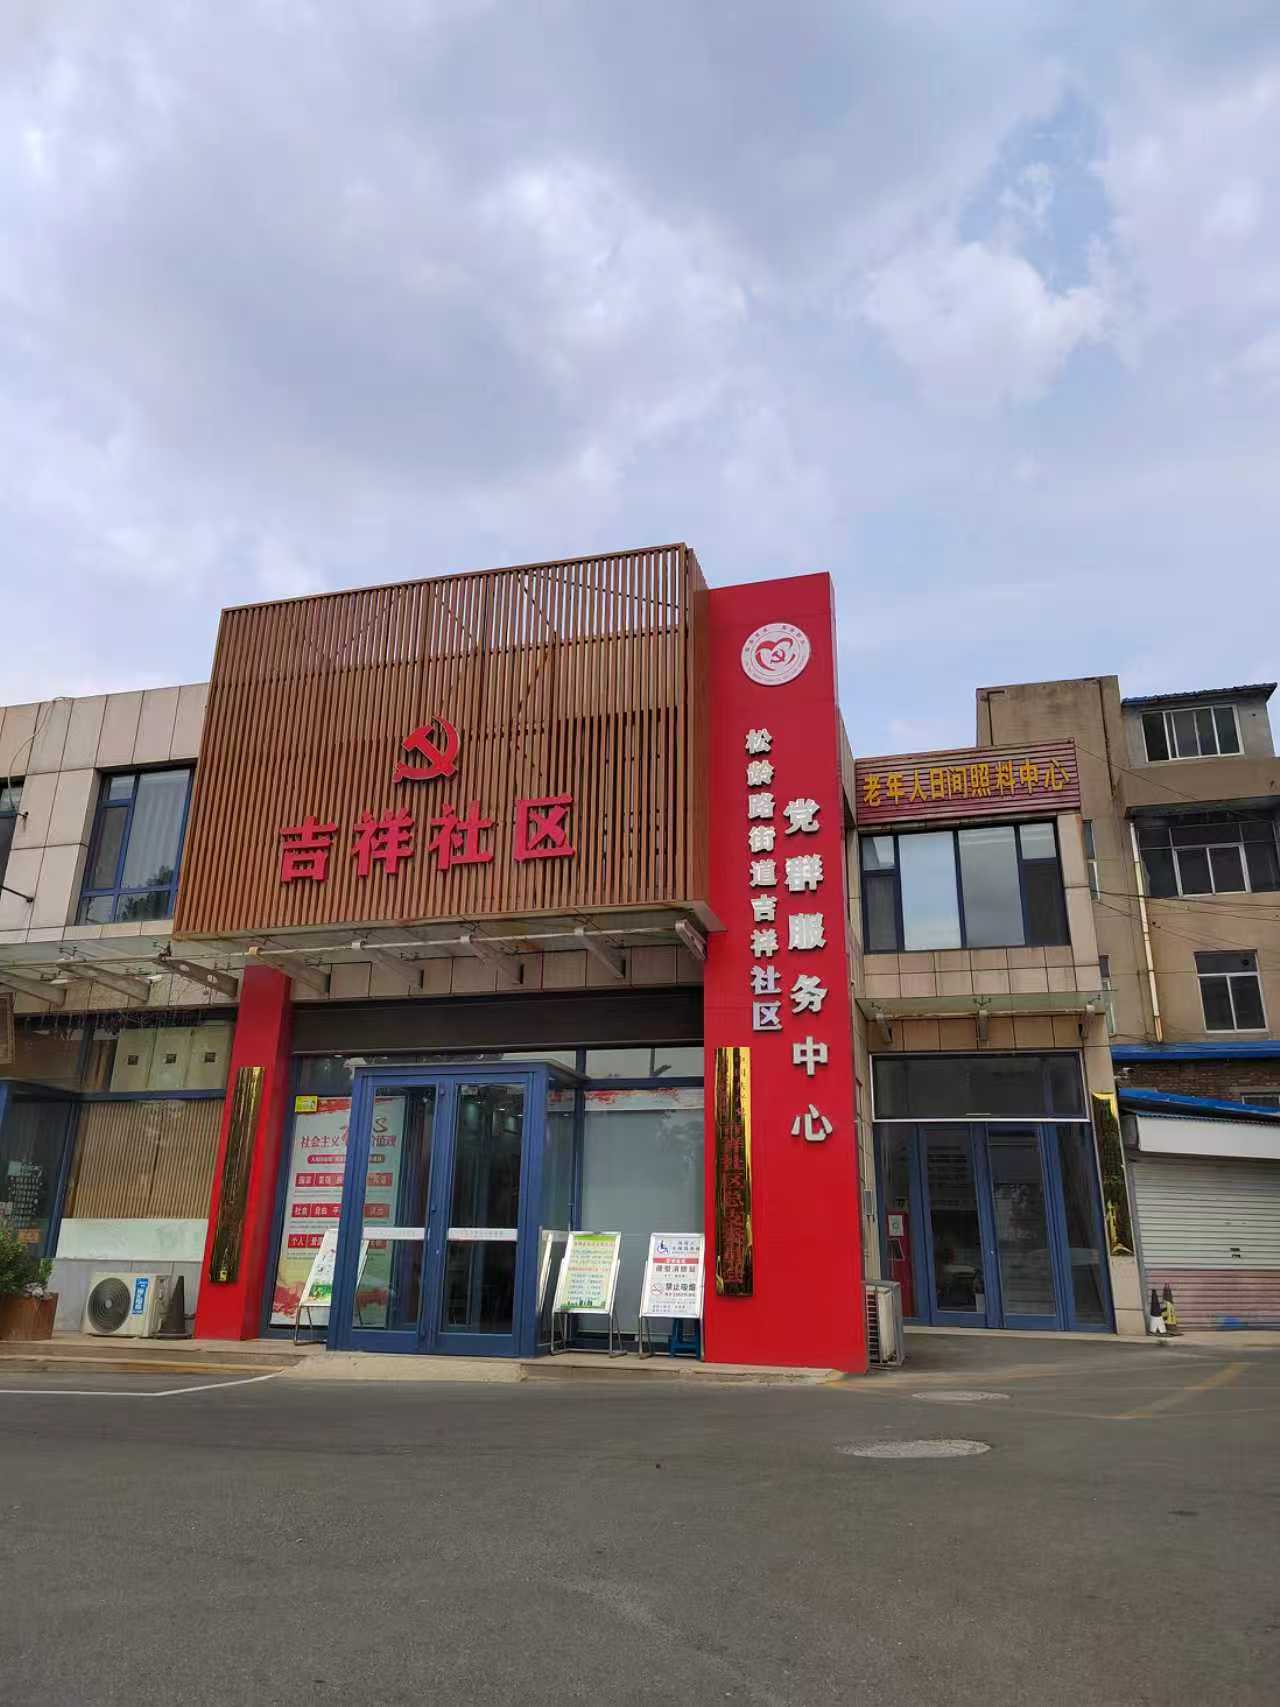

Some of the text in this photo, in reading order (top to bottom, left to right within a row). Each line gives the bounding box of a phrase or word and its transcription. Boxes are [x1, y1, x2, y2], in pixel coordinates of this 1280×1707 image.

[280, 792, 576, 884] 吉祥社区
[746, 728, 783, 1031] 松龄路街道吉祥社区
[863, 758, 1070, 807] 老年人日间照料中心
[783, 799, 833, 1142] 党群服务中心
